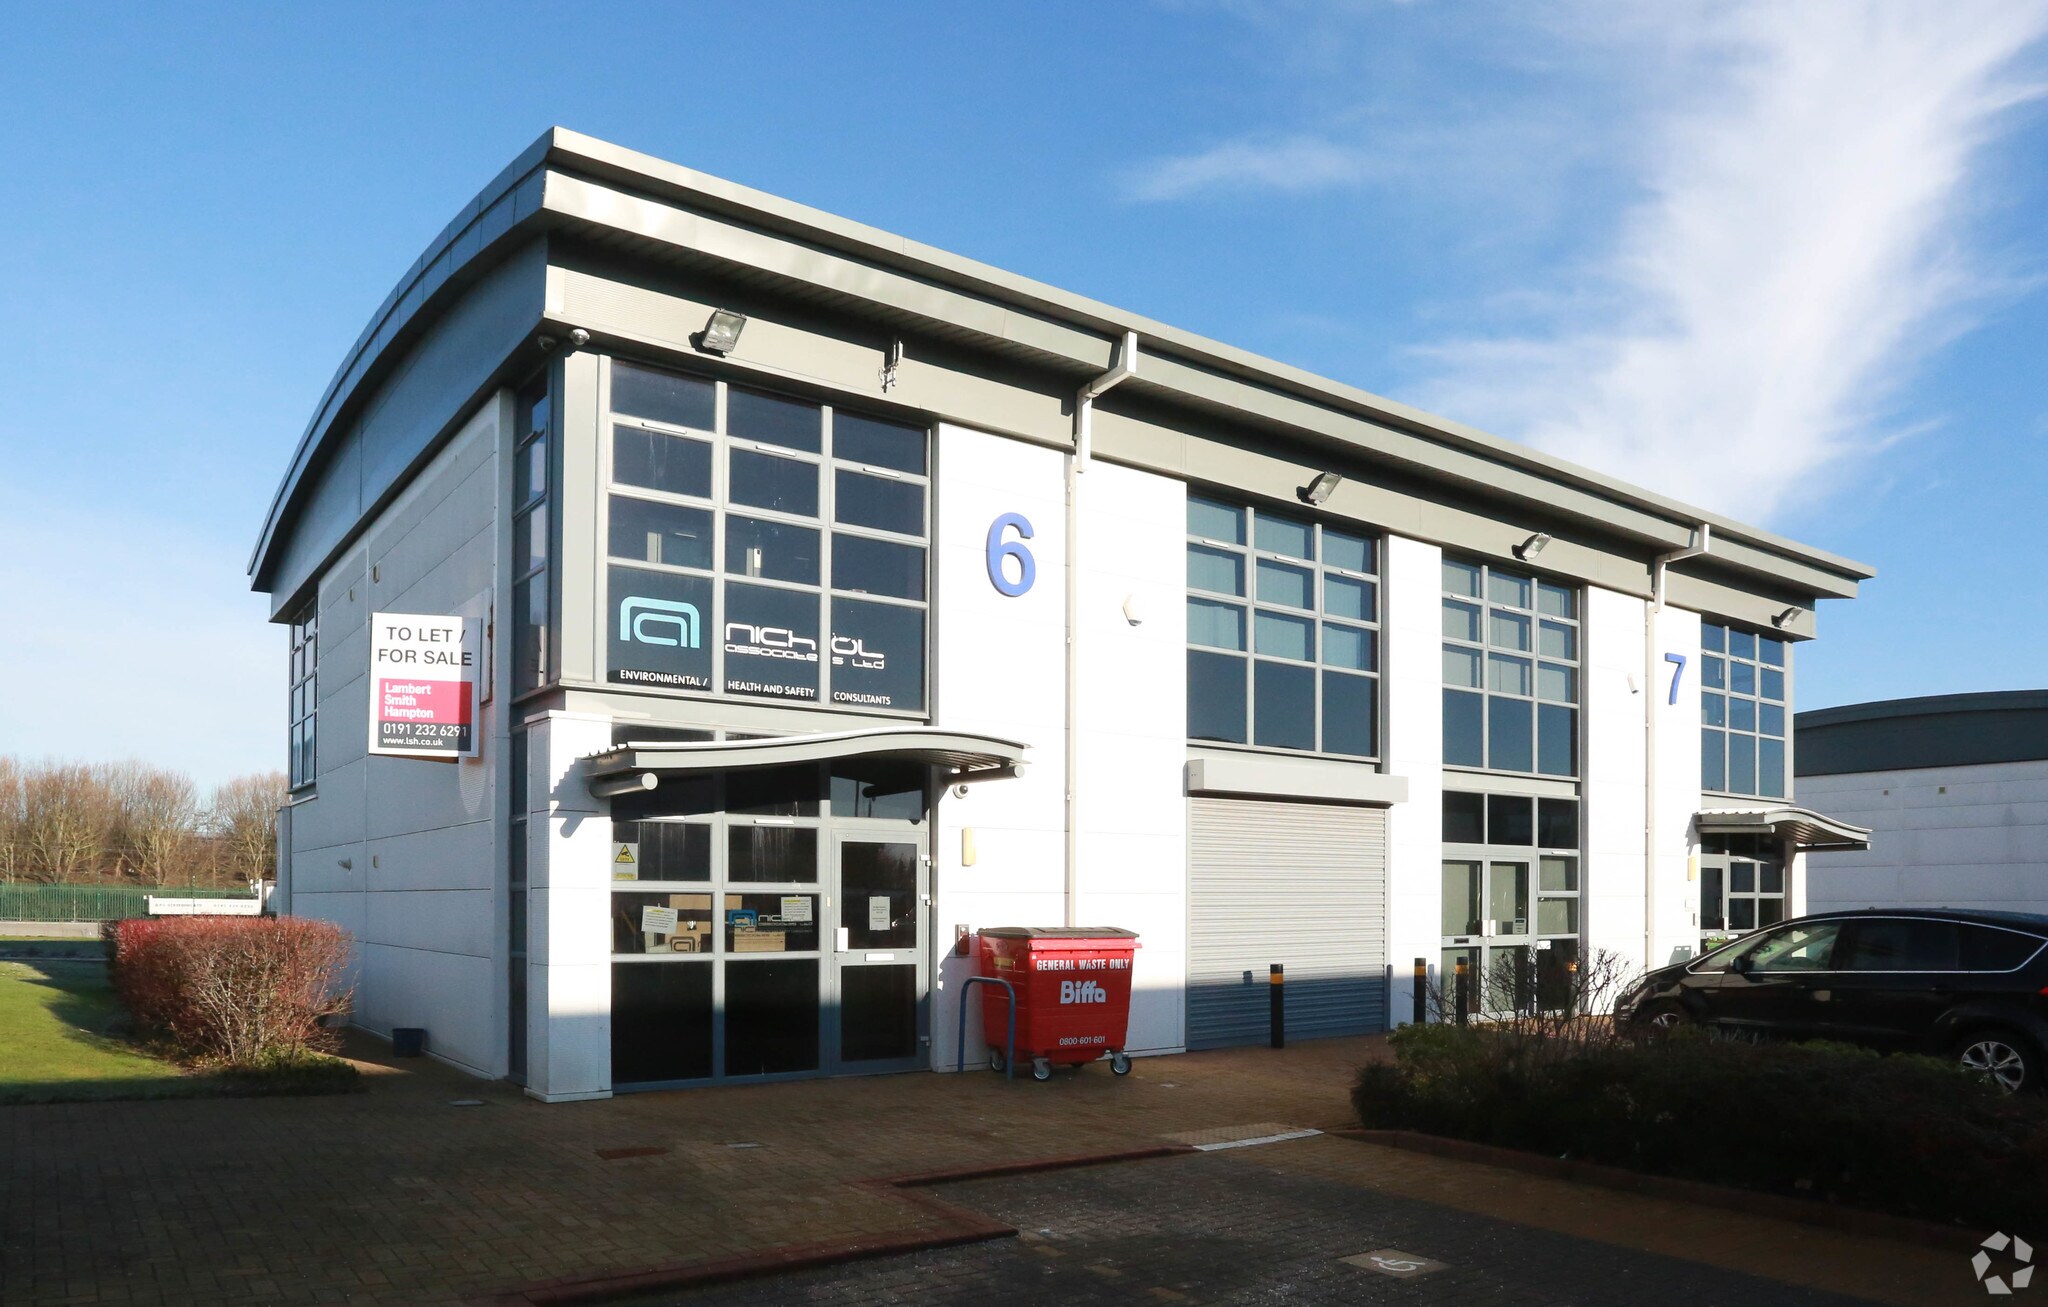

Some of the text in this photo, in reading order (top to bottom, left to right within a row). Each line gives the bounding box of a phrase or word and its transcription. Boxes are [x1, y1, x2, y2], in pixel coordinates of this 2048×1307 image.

[985, 512, 1036, 597] 6
[386, 626, 466, 644] TO LET /
[378, 648, 473, 666] FOR SALE
[620, 669, 701, 686] ENVIRONMENTAL
[1664, 652, 1687, 705] 7
[385, 682, 432, 695] Lambert
[727, 680, 891, 705] HEALTH AND SAFETY CONSULTANTS
[384, 694, 417, 706] Smith
[384, 705, 434, 719] Hampton
[383, 723, 467, 737] 0191 232 6291
[382, 737, 444, 746] www.lsh.co.uk
[1036, 958, 1130, 971] GENERAL WASTE ONLY
[1059, 980, 1107, 1005] Biffa
